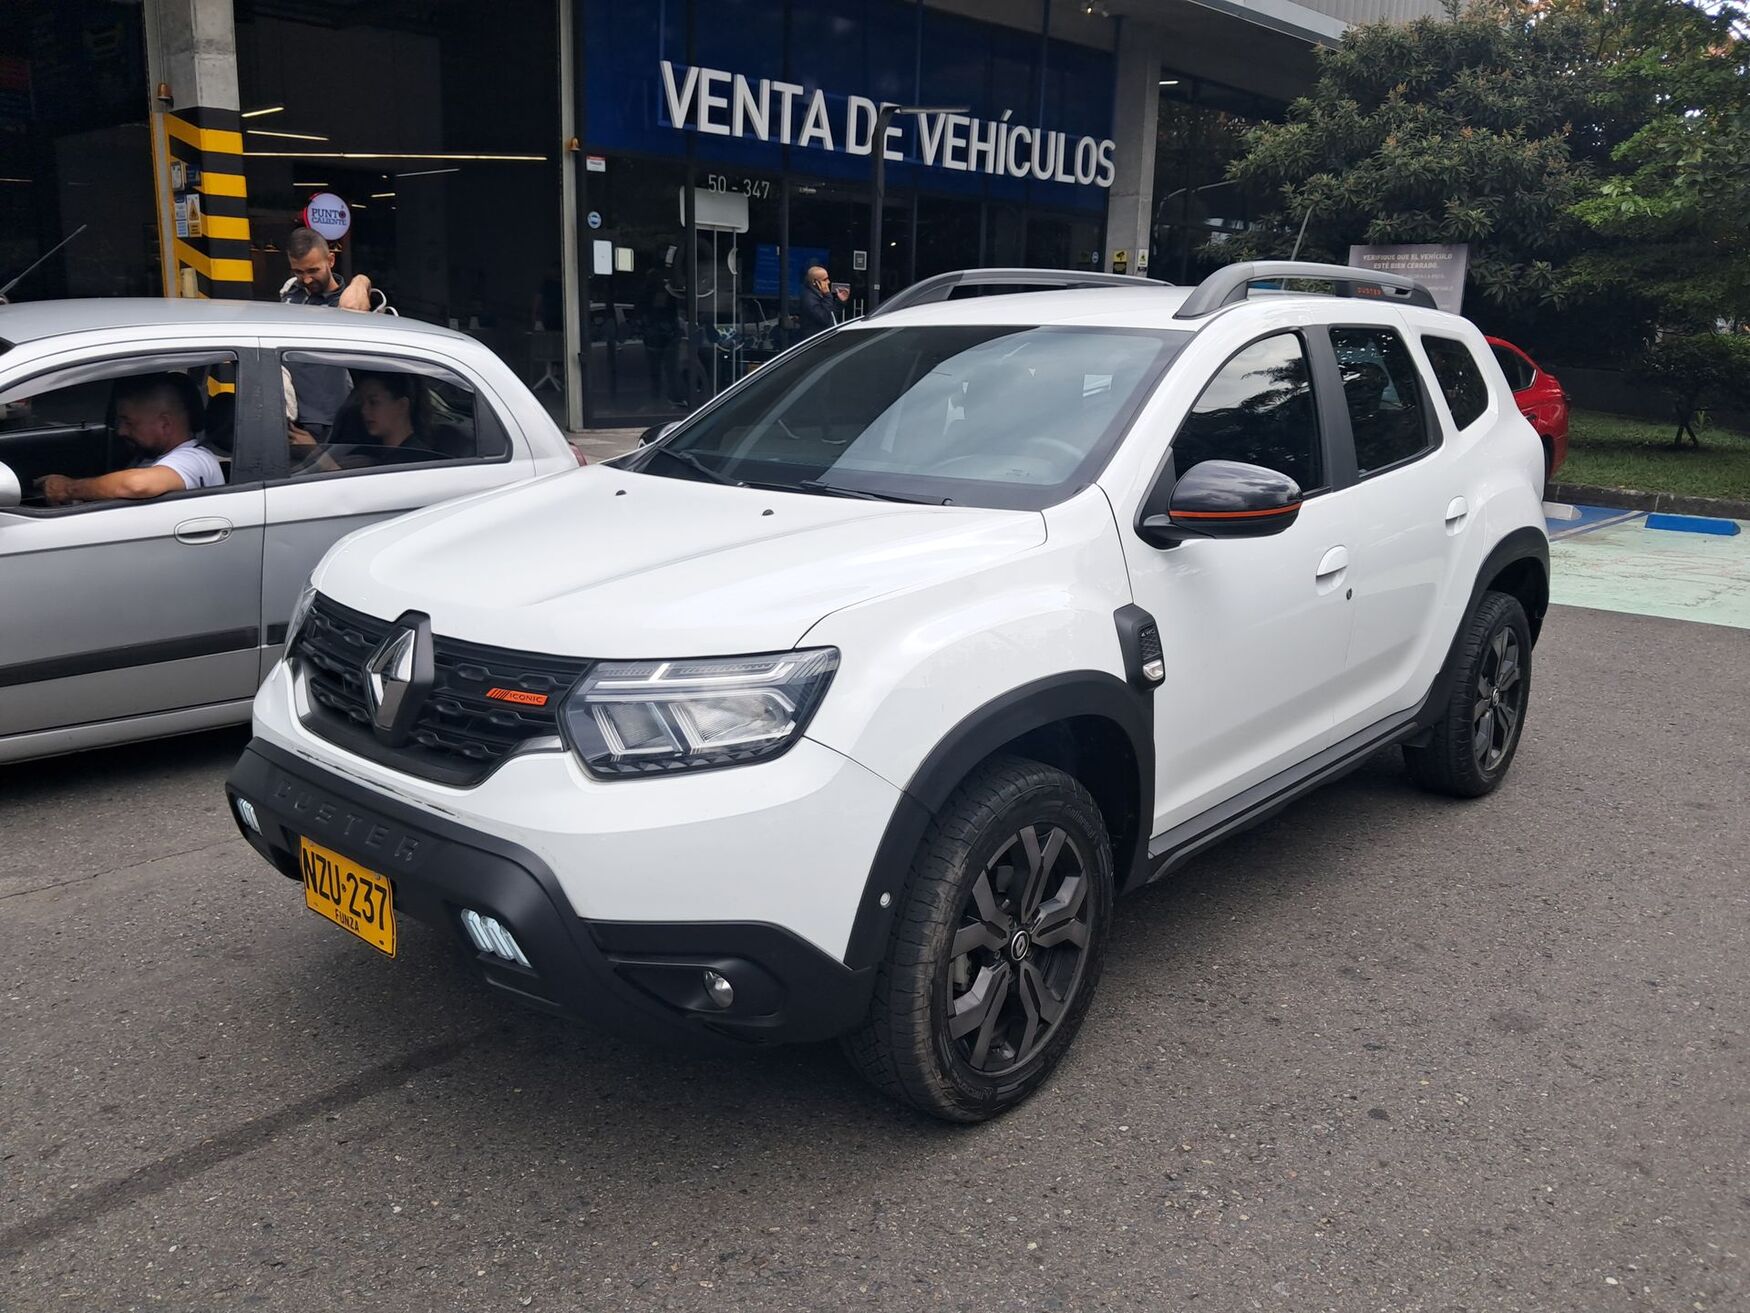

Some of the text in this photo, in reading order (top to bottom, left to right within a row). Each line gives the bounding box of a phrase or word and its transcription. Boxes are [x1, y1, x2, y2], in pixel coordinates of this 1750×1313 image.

[660, 60, 1116, 188] VENTA DE VEHÍCULOS
[708, 174, 727, 194] 50
[743, 179, 770, 200] 347
[311, 208, 346, 219] PUNTO
[509, 693, 543, 703] ICONIC
[334, 908, 360, 933] FUNZA
